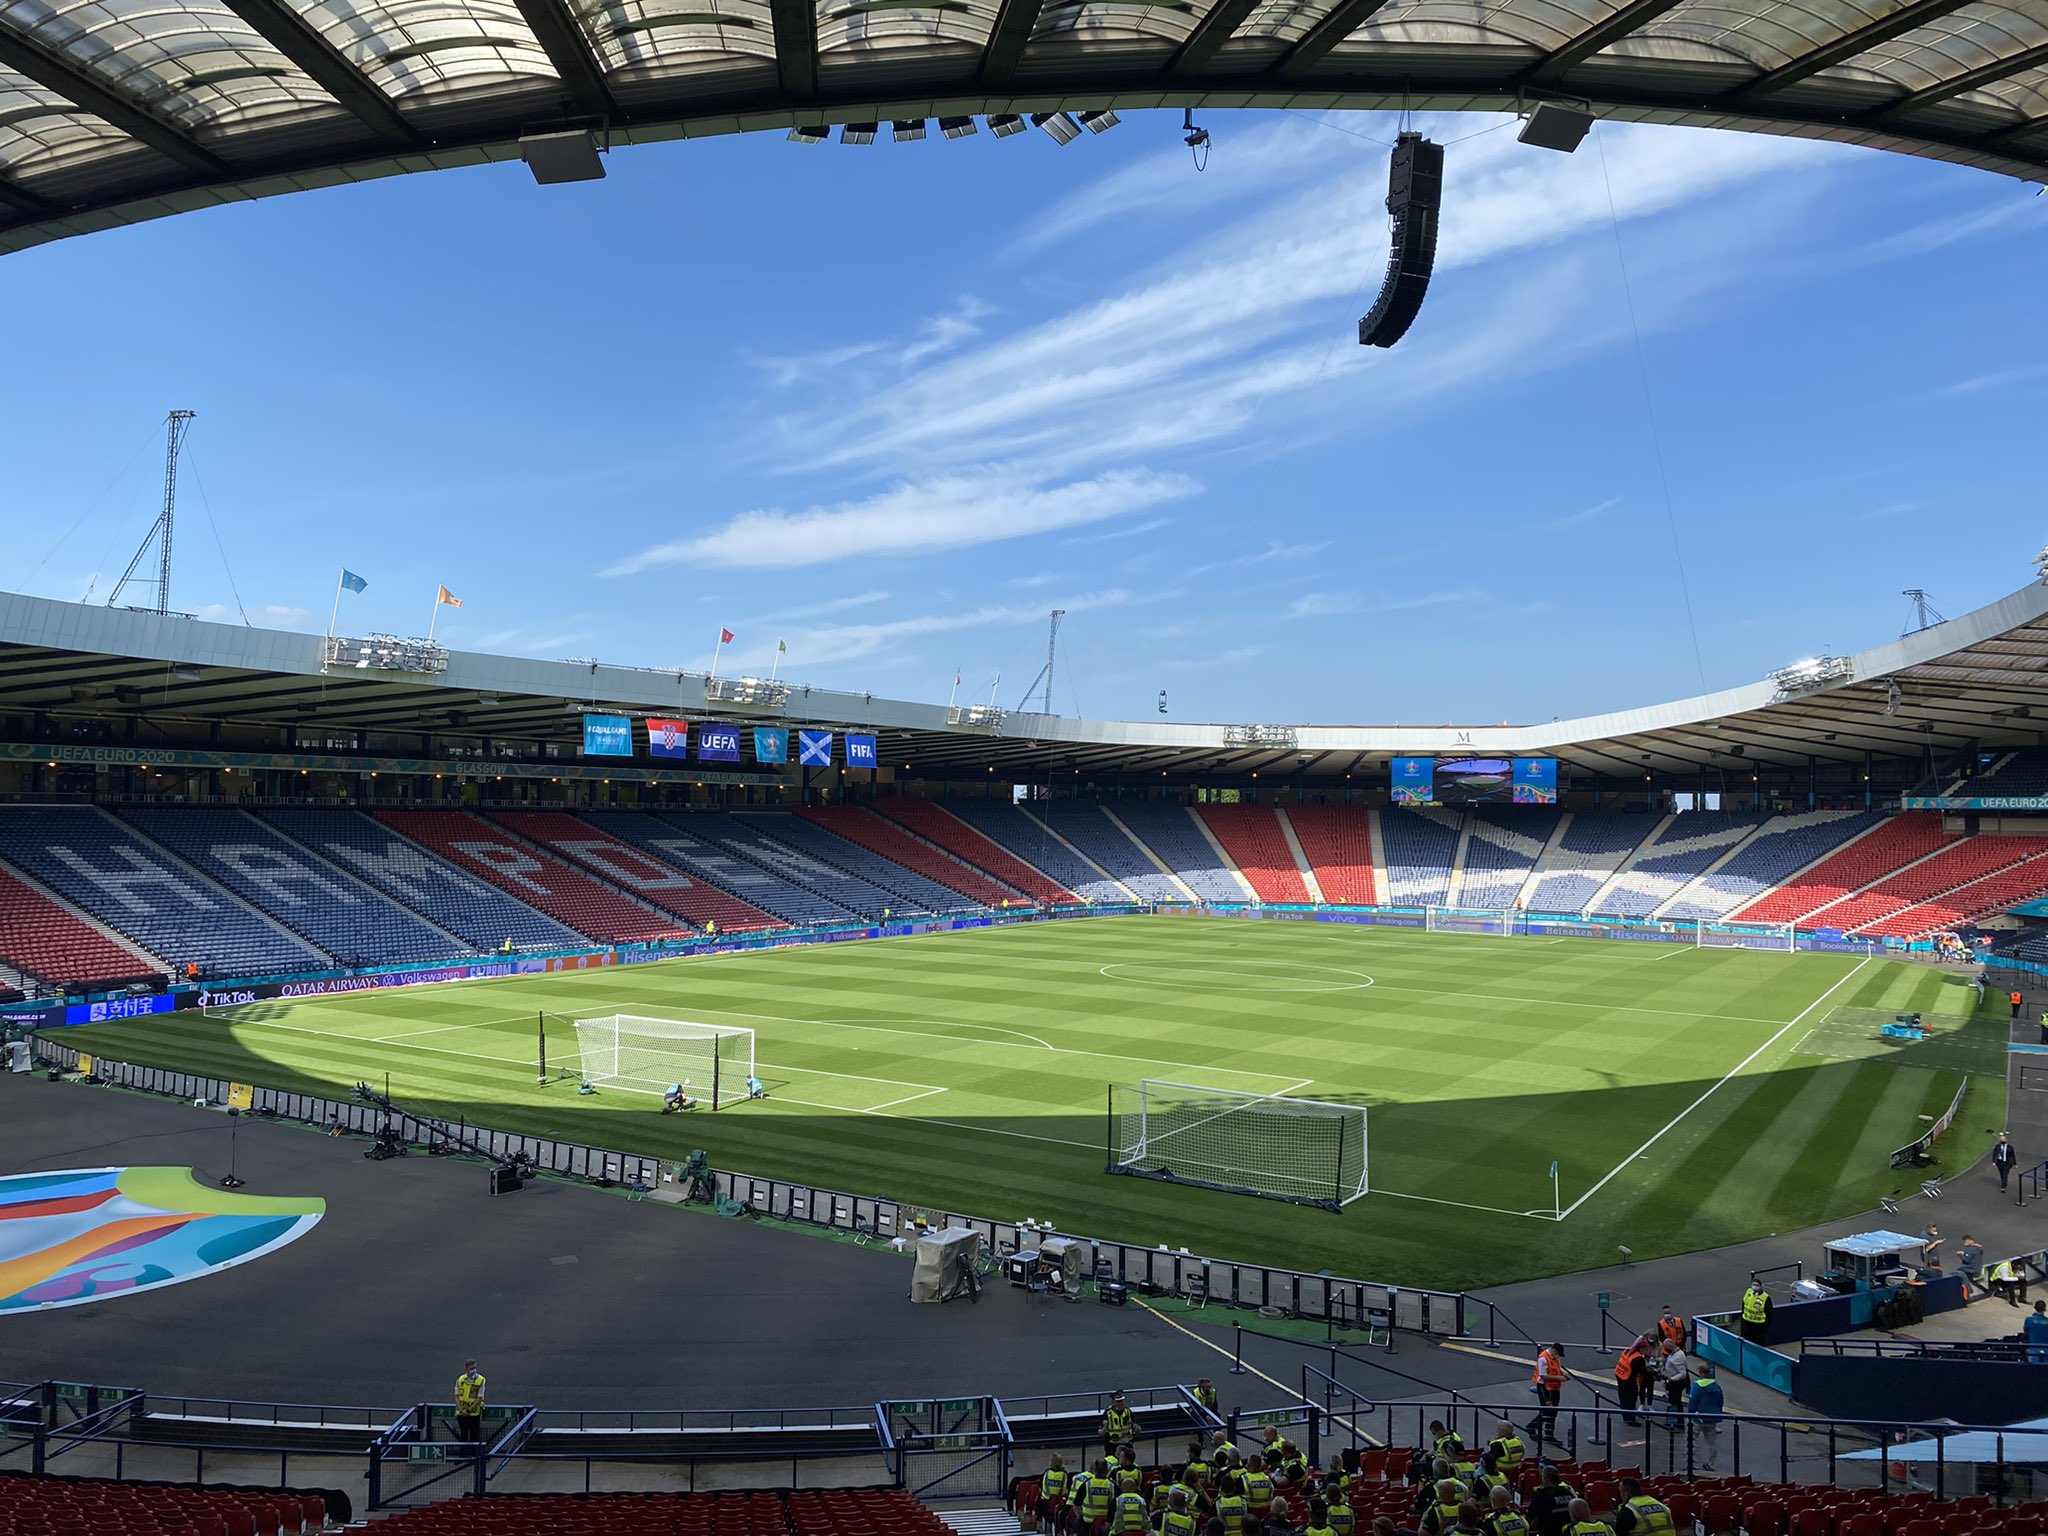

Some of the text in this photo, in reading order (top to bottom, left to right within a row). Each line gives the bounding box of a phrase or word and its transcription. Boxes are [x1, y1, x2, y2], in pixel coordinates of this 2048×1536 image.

[701, 735, 736, 750] UEFA
[1456, 732, 1471, 743] M
[51, 747, 175, 763] UEFA EURO 2020
[850, 744, 873, 758] FIFA
[455, 763, 507, 775] GLASGOW
[701, 773, 759, 783] UEFA EURO 2020
[1981, 798, 2008, 808] UEFA
[2009, 799, 2037, 808] EURO
[45, 841, 850, 914] HAMPDEN
[1093, 908, 1125, 917] Hisense
[1280, 912, 1304, 920] TikTok
[1329, 914, 1357, 923] vivo
[1375, 917, 1418, 926] Booking.com
[925, 922, 943, 932] FedEx
[962, 920, 981, 930] vivo
[1546, 927, 1593, 937] Heineken
[1610, 930, 1667, 942] Hisense
[694, 944, 736, 955] Booking.com
[1820, 942, 1876, 952] Booking.com
[624, 950, 677, 964] Hisense
[400, 970, 460, 984] Volkswagen
[281, 976, 379, 997] QATAR AIRWAYS
[212, 990, 255, 1005] TikTok
[107, 998, 153, 1019] 支付宝
[1641, 1504, 1663, 1514] POLICE
[1167, 1524, 1188, 1536] POLICE
[1502, 1520, 1524, 1531] POLICE
